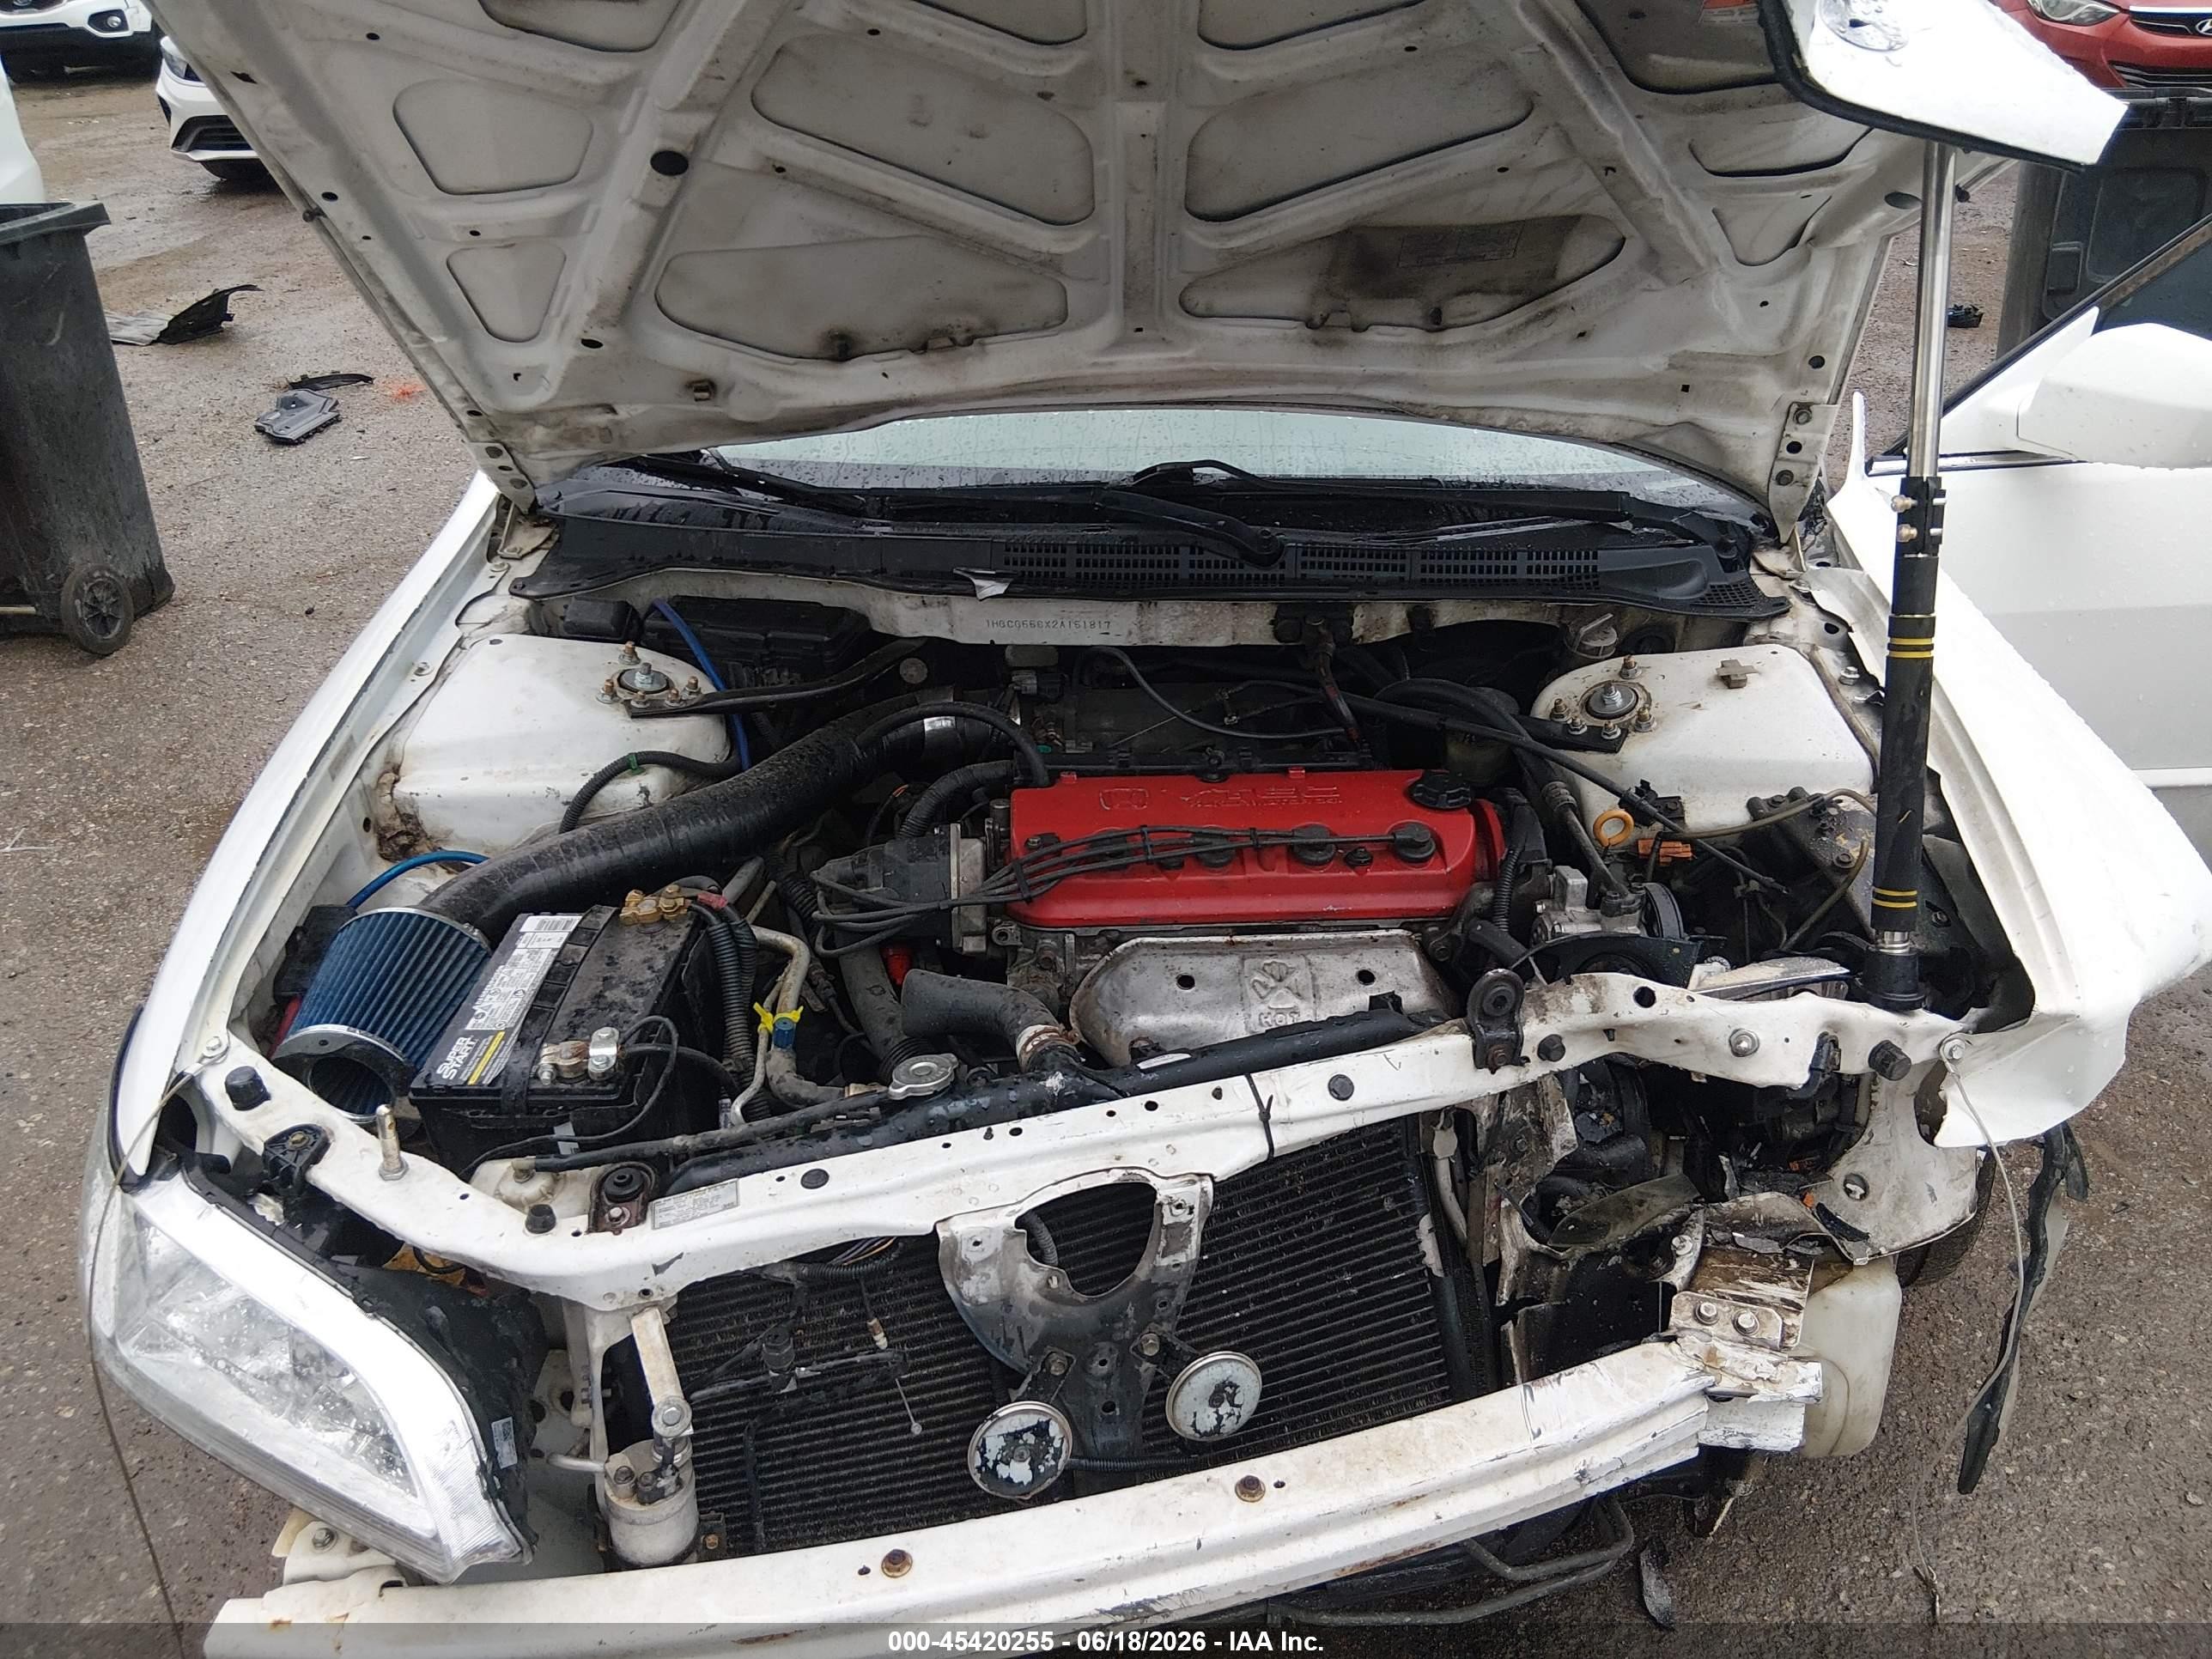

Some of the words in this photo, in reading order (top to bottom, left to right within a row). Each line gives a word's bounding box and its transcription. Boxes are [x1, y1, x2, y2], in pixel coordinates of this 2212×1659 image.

[1258, 1012, 1301, 1027] HOT
[436, 1036, 469, 1074] SUPER
[442, 1037, 476, 1080] START
